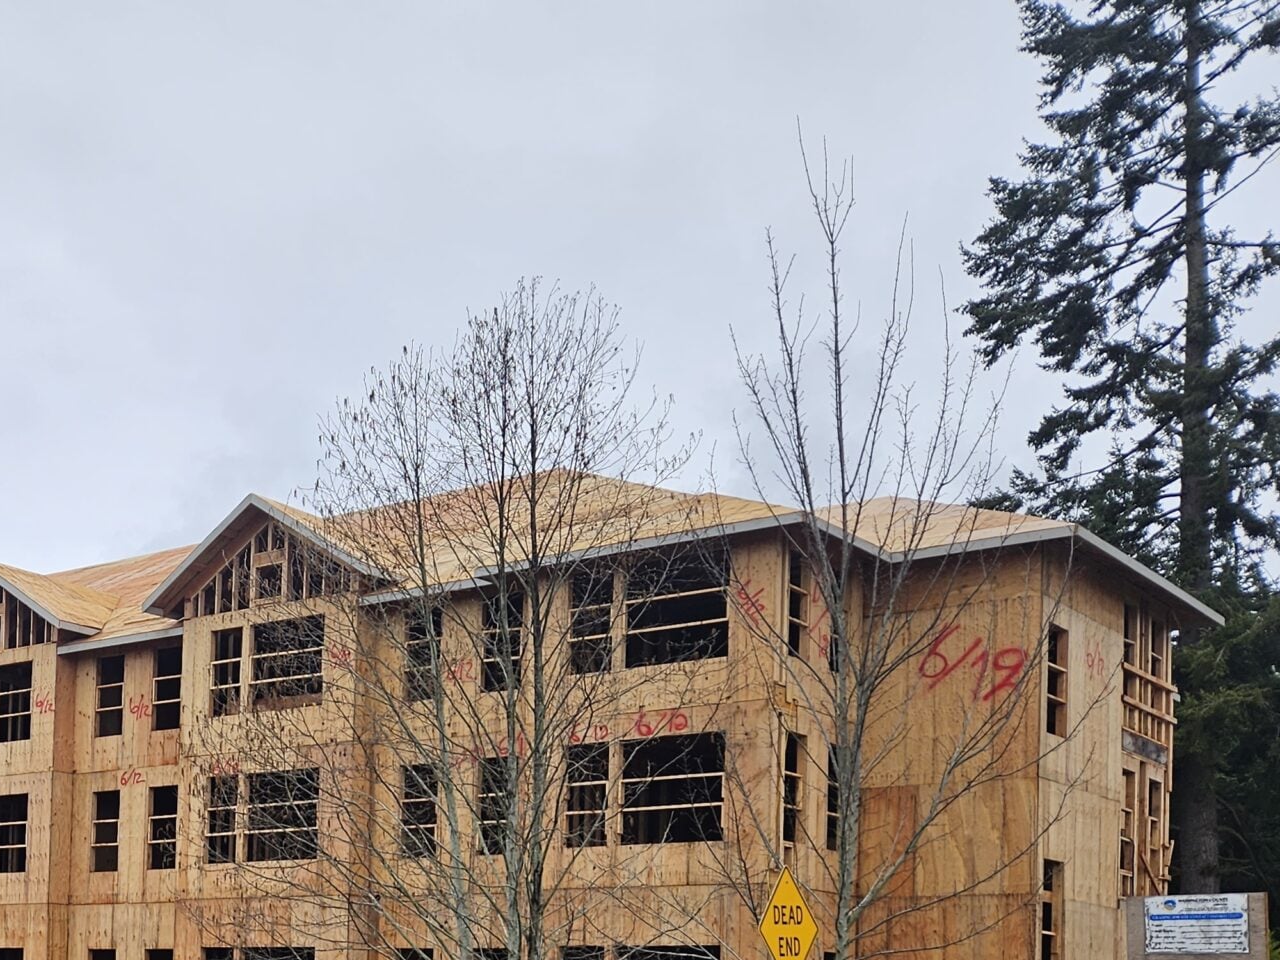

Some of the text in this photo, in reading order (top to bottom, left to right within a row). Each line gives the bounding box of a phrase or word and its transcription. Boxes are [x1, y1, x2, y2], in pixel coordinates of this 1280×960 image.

[35, 691, 55, 714] 6/12
[130, 696, 152, 720] 6/12
[121, 768, 145, 786] 6/12
[773, 905, 803, 925] DEAD
[779, 936, 801, 957] END
